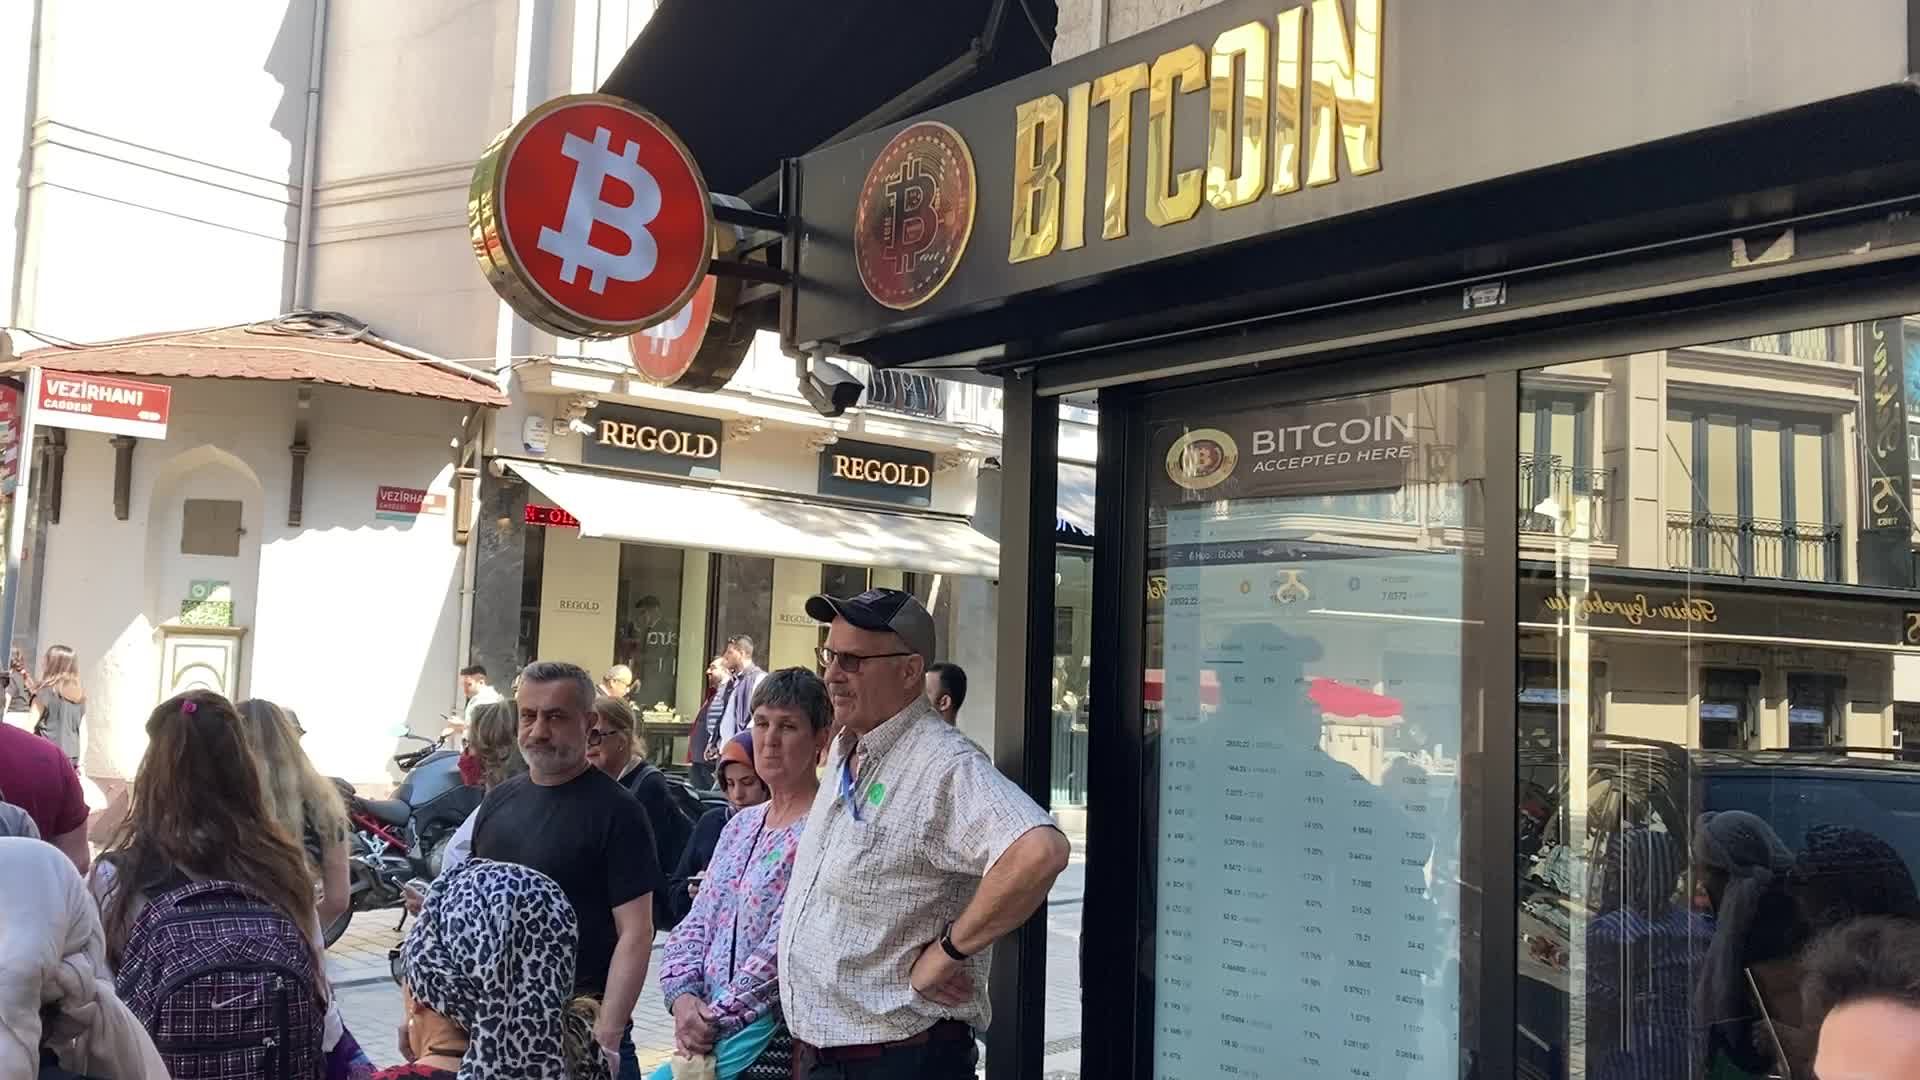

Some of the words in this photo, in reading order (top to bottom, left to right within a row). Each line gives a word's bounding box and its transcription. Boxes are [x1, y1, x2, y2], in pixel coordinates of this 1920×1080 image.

[1008, 0, 1382, 263] BITCOIN
[600, 420, 718, 459] REGOLD
[1252, 412, 1415, 456] BITCOIN
[833, 454, 931, 488] REGOLD
[1253, 451, 1351, 473] ACCEPTED
[1357, 445, 1413, 463] HERE
[1218, 550, 1244, 559] Global
[560, 600, 599, 611] REGOLD
